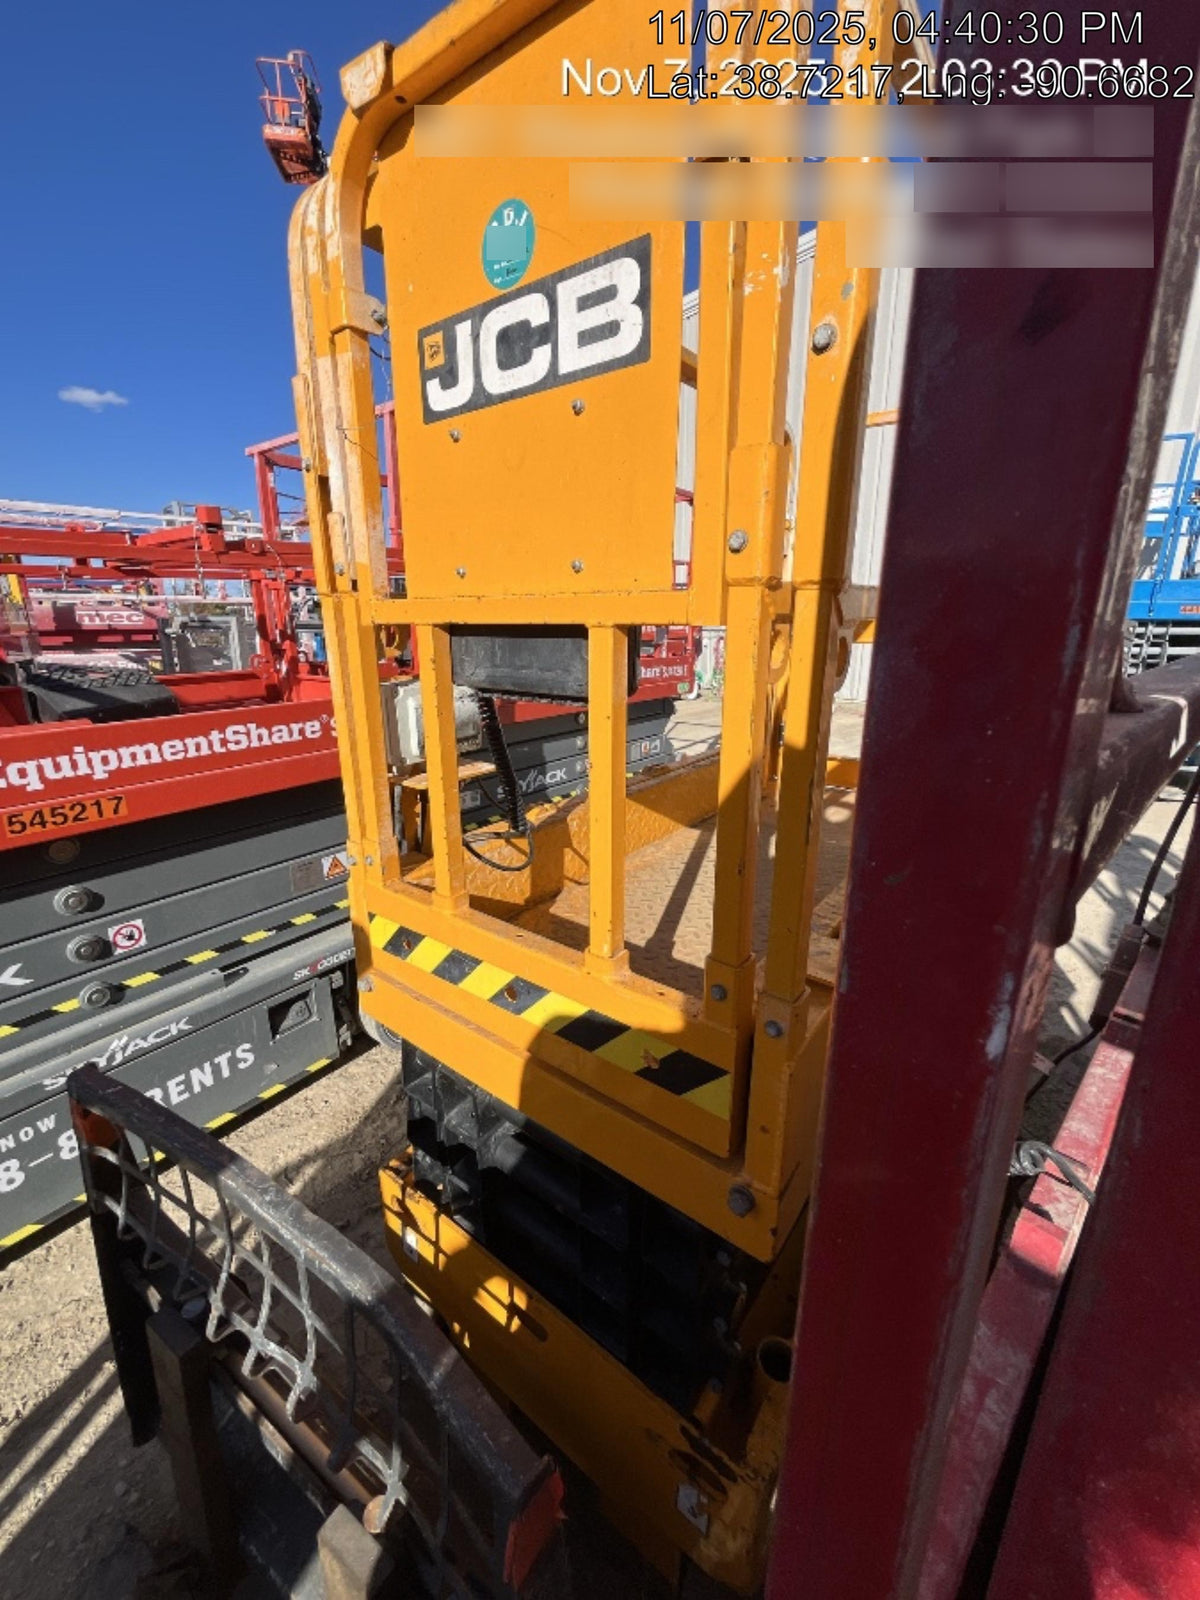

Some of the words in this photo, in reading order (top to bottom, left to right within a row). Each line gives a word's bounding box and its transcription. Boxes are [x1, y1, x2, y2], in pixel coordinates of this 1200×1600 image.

[426, 257, 643, 411] JCB
[75, 610, 144, 625] mec
[7, 796, 123, 835] 545217
[0, 1113, 57, 1152] NOW
